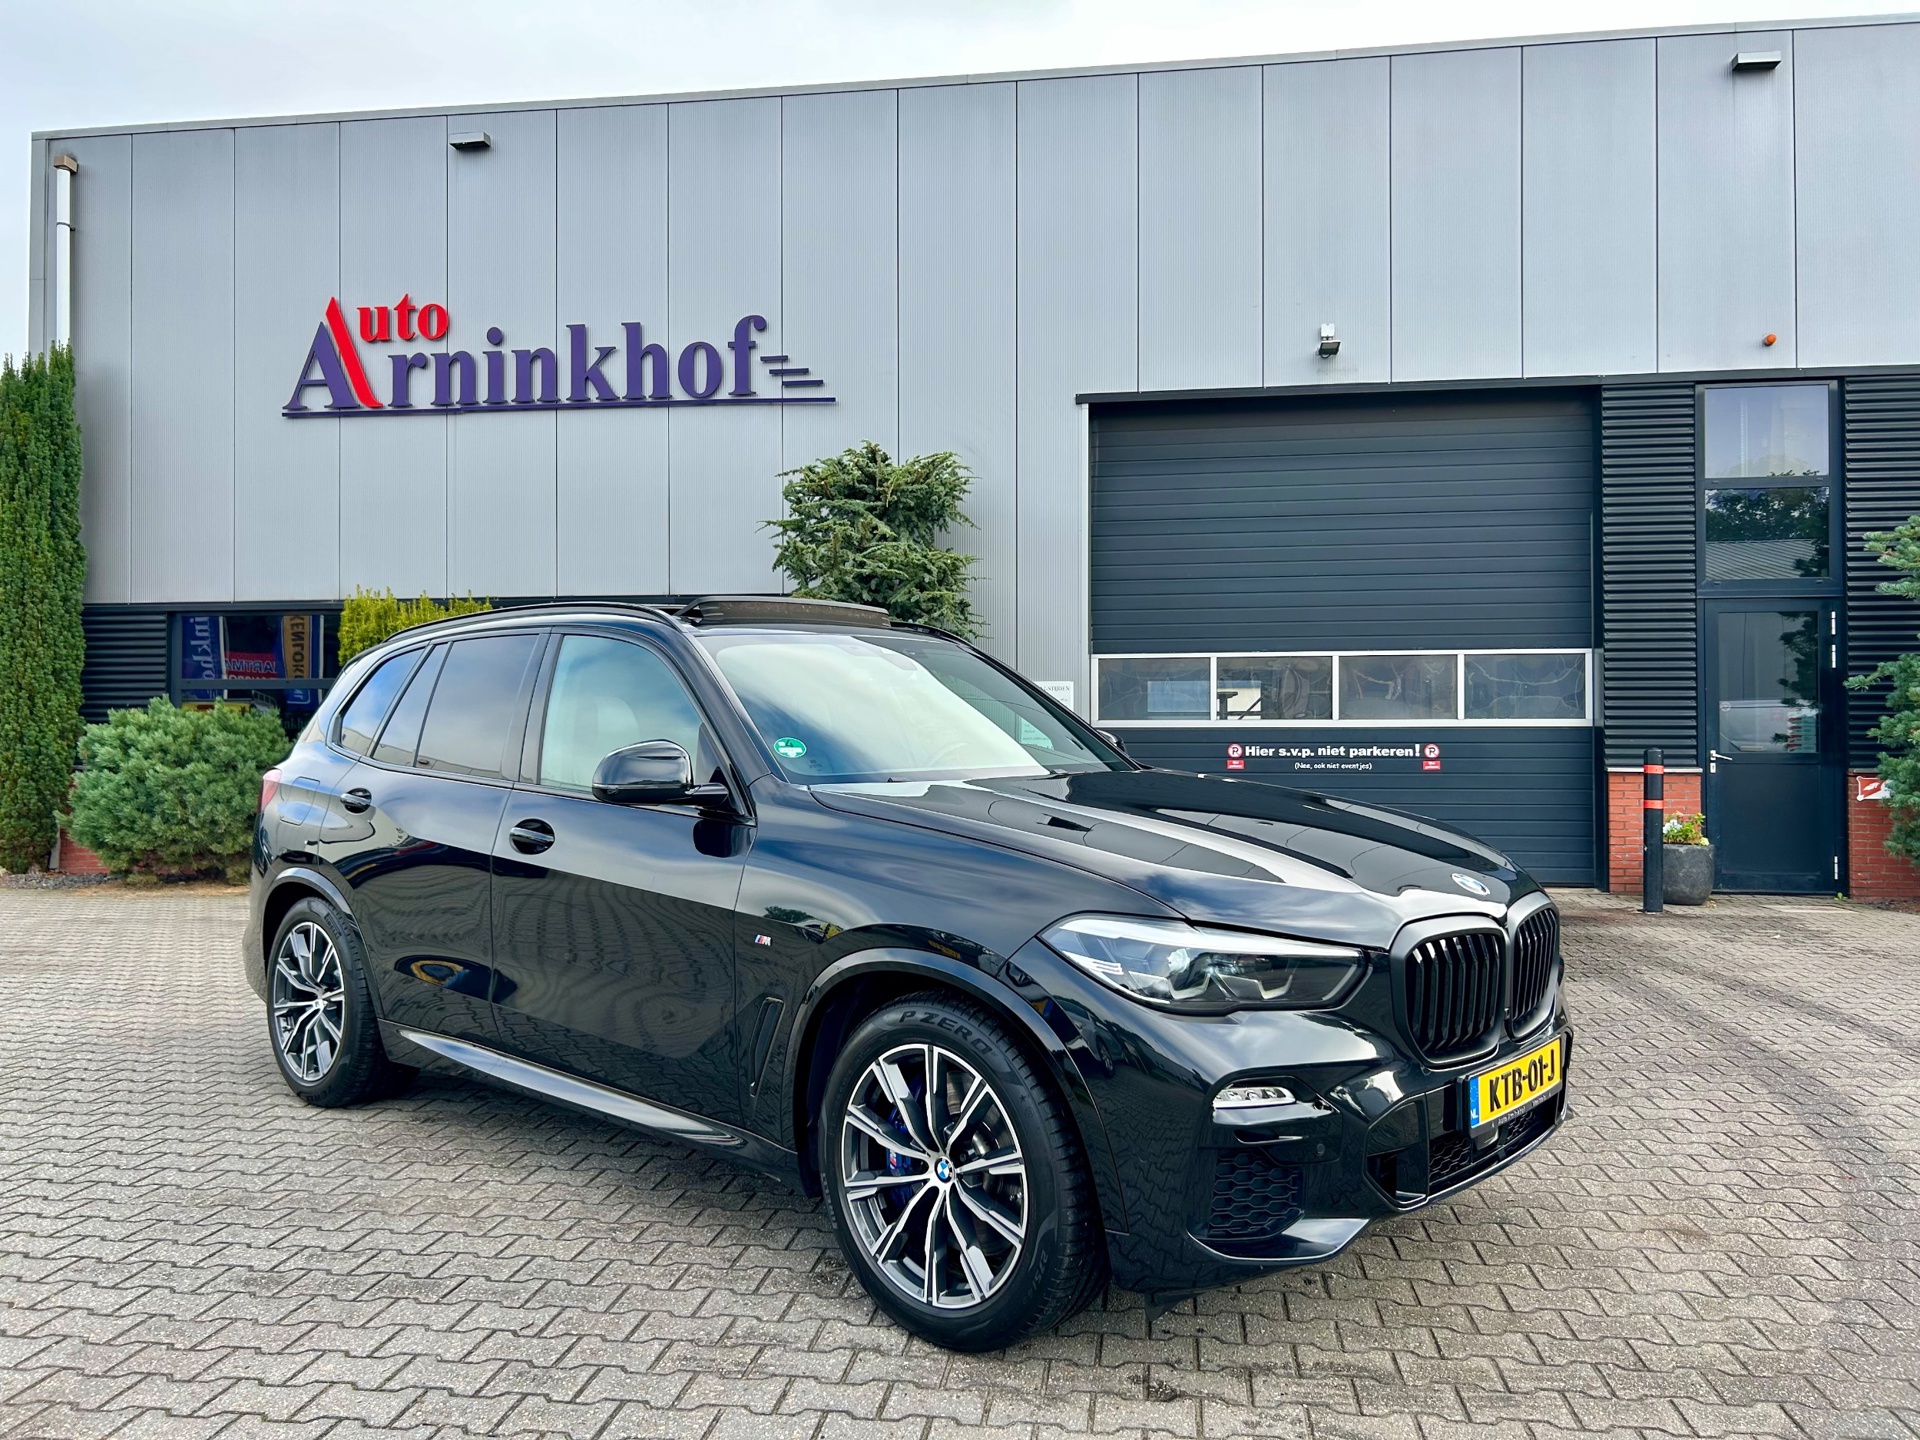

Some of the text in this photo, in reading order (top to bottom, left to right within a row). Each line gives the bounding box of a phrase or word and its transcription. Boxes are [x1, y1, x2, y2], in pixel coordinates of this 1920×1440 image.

[282, 315, 767, 410] Arninkhof
[1245, 743, 1420, 759] Hier s.v.p. niet parkeren!
[1294, 762, 1313, 770] (Nee,
[1341, 762, 1373, 771] eventjes)
[920, 1011, 996, 1055] ZERO
[1489, 1049, 1555, 1113] KTB-01-J
[1470, 1108, 1479, 1119] NL
